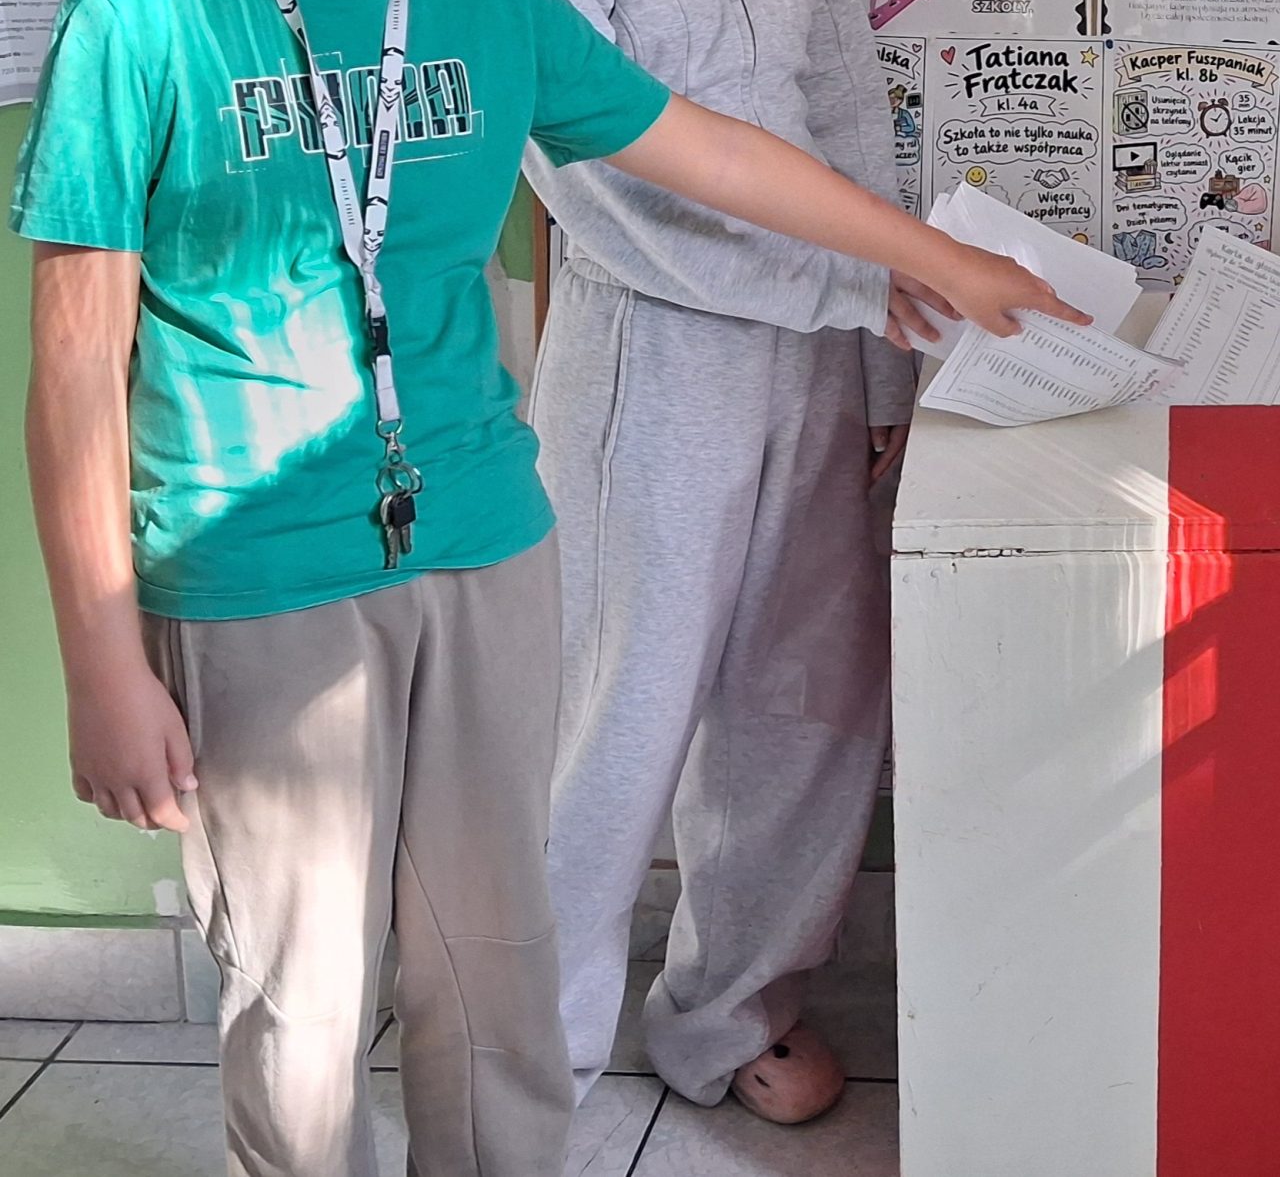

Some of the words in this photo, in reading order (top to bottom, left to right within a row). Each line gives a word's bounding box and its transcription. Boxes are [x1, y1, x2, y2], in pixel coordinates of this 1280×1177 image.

[966, 43, 1069, 70] Tatiana
[1130, 54, 1182, 71] Kacper
[1187, 51, 1265, 77] Fuszpaniak
[1177, 69, 1194, 81] kl.
[1199, 69, 1218, 82] 8b
[963, 69, 1077, 98] Frątczak
[997, 98, 1015, 110] kl.
[1018, 97, 1038, 110] 4a
[943, 128, 985, 144] Szkoła
[989, 127, 1000, 138] to
[1004, 128, 1021, 138] nie
[1024, 127, 1053, 142] tylko
[1057, 130, 1093, 141] nauka
[1234, 127, 1245, 135] 35
[1247, 127, 1272, 135] minut
[954, 145, 968, 157] to
[972, 141, 1008, 154] także
[1014, 142, 1083, 158] współpraca
[1225, 154, 1252, 165] Kącik
[1238, 164, 1256, 174] gier
[1038, 192, 1074, 205] Więcej
[1024, 204, 1091, 219] współpracy
[1116, 203, 1130, 213] Dni
